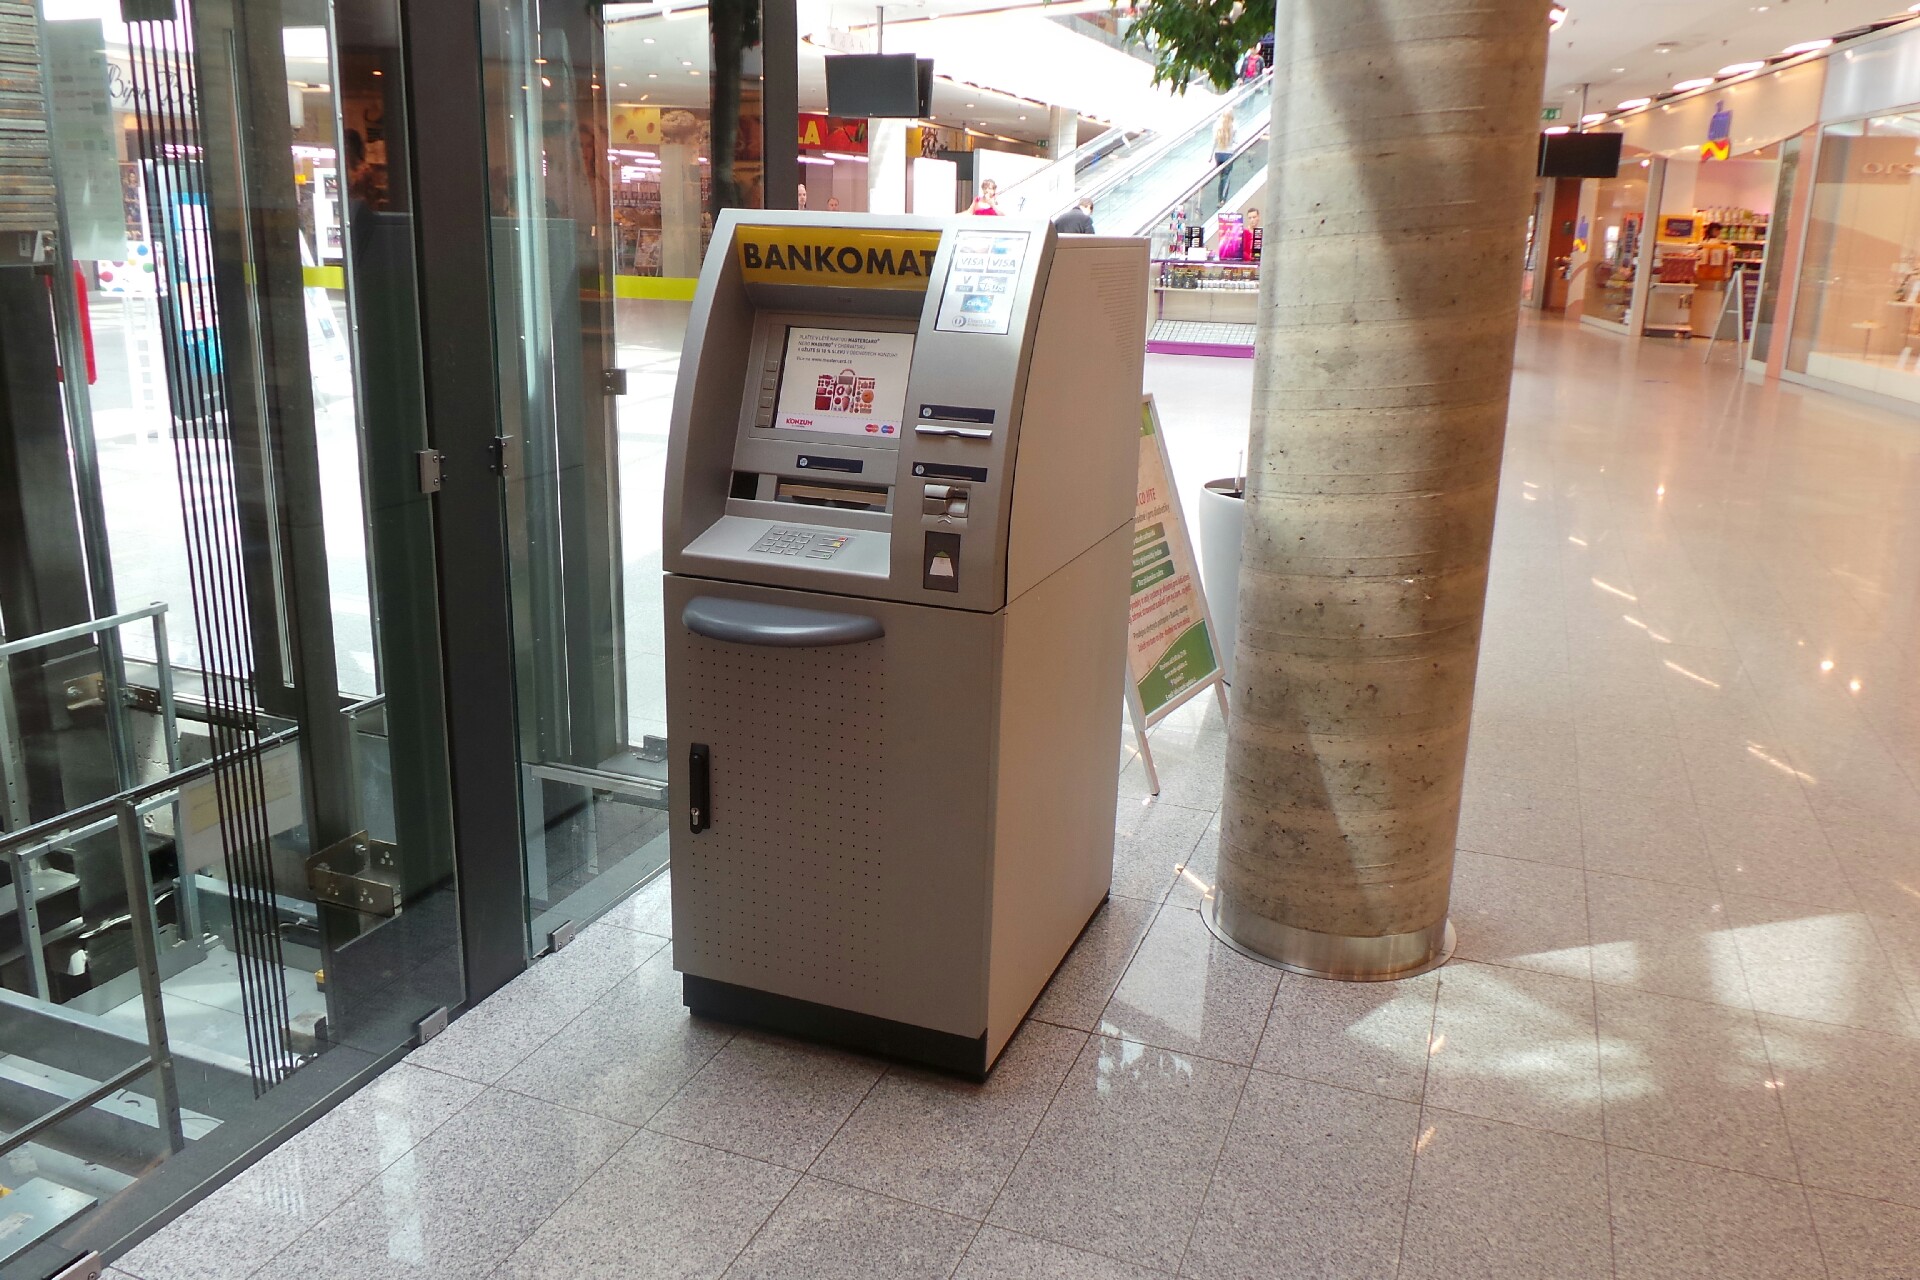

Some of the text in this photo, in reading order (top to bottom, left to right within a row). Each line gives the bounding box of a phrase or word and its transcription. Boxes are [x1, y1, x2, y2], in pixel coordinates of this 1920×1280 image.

[743, 243, 937, 277] BANKOMAT
[961, 257, 1016, 268] VISA VISA
[786, 418, 812, 426] KONZUM
